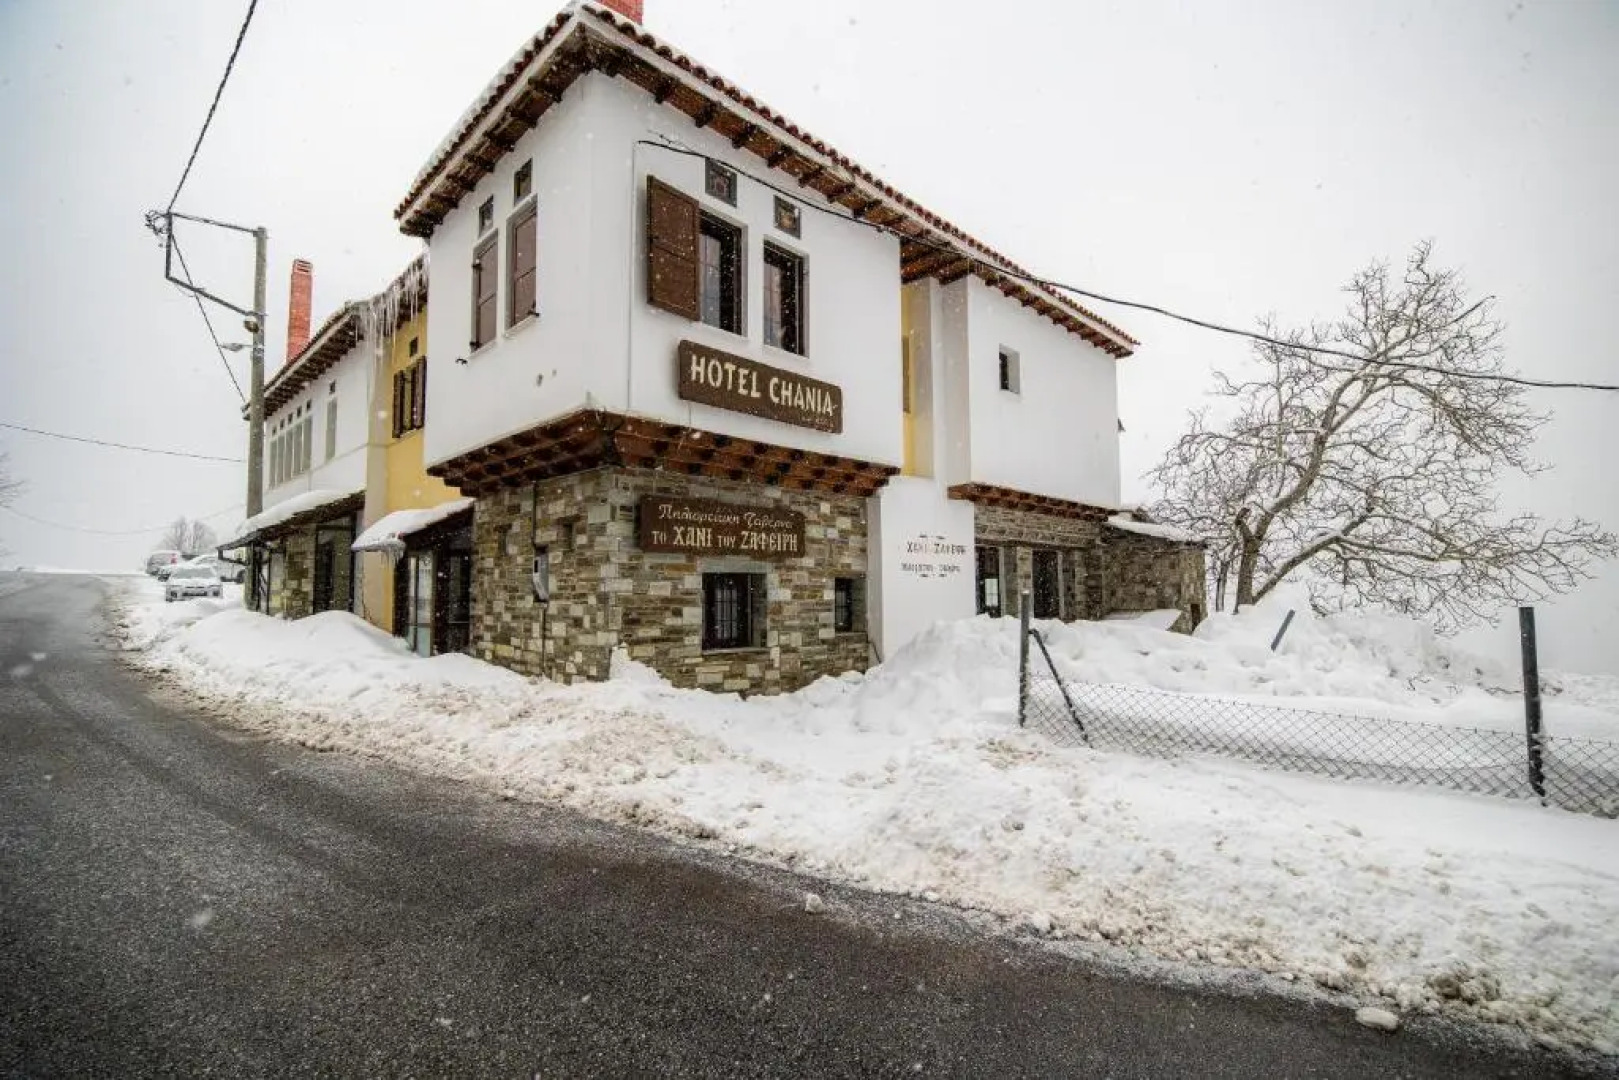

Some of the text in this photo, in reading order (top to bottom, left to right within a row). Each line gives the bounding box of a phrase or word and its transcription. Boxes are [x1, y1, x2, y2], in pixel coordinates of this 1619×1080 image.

[691, 354, 833, 417] HOTEL CHANIA
[651, 530, 667, 545] ΤΟ
[673, 526, 713, 548] ΧΑΝΙ
[717, 535, 736, 548] ΤΟΥ
